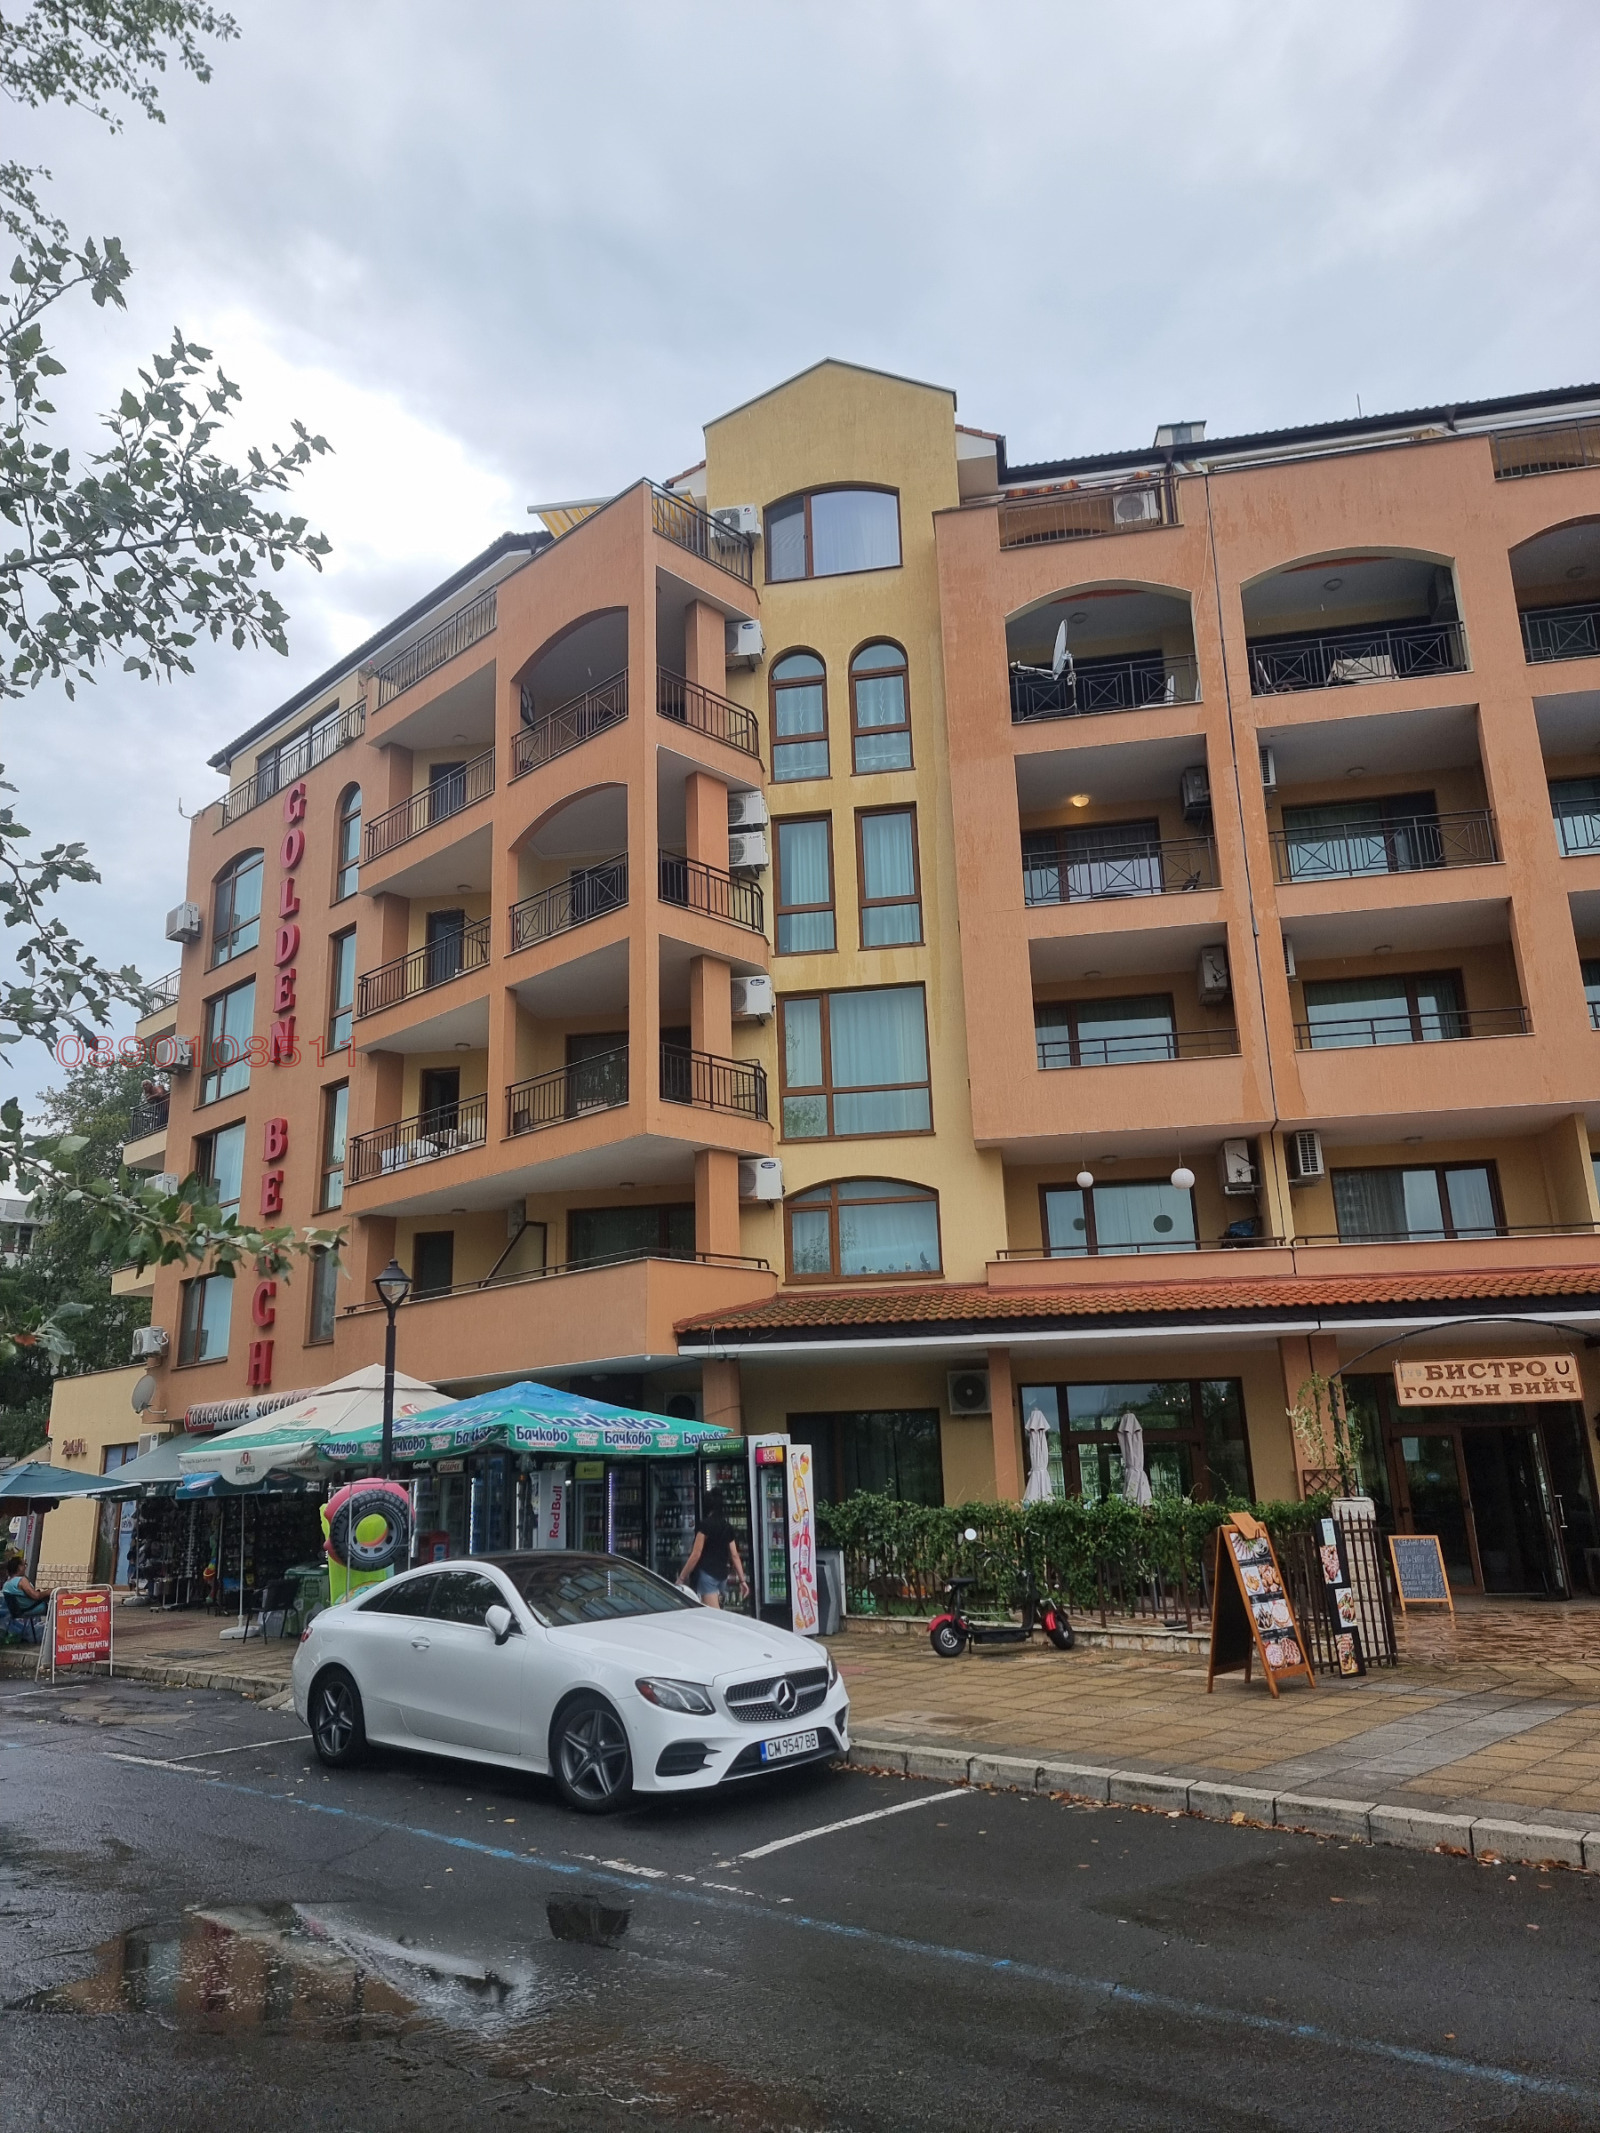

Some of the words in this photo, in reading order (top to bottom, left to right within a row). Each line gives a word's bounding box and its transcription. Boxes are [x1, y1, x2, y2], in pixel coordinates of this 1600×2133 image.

[269, 782, 307, 1064] GOLDEN
[1424, 1360, 1547, 1381] БИСТРО
[1404, 1383, 1502, 1399] ГОЛДЪН
[1509, 1378, 1577, 1395] БИЙЧ
[392, 1436, 425, 1452] ачково
[515, 1425, 568, 1442] Бачково
[604, 1430, 652, 1445] Бачково
[552, 1486, 563, 1511] Bull
[549, 1512, 560, 1538] Red
[69, 1615, 97, 1624] E-LIQUIDS
[67, 1627, 100, 1638] LIQUA
[767, 1740, 781, 1757] CM
[782, 1735, 804, 1754] 9547
[805, 1733, 817, 1749] BB
